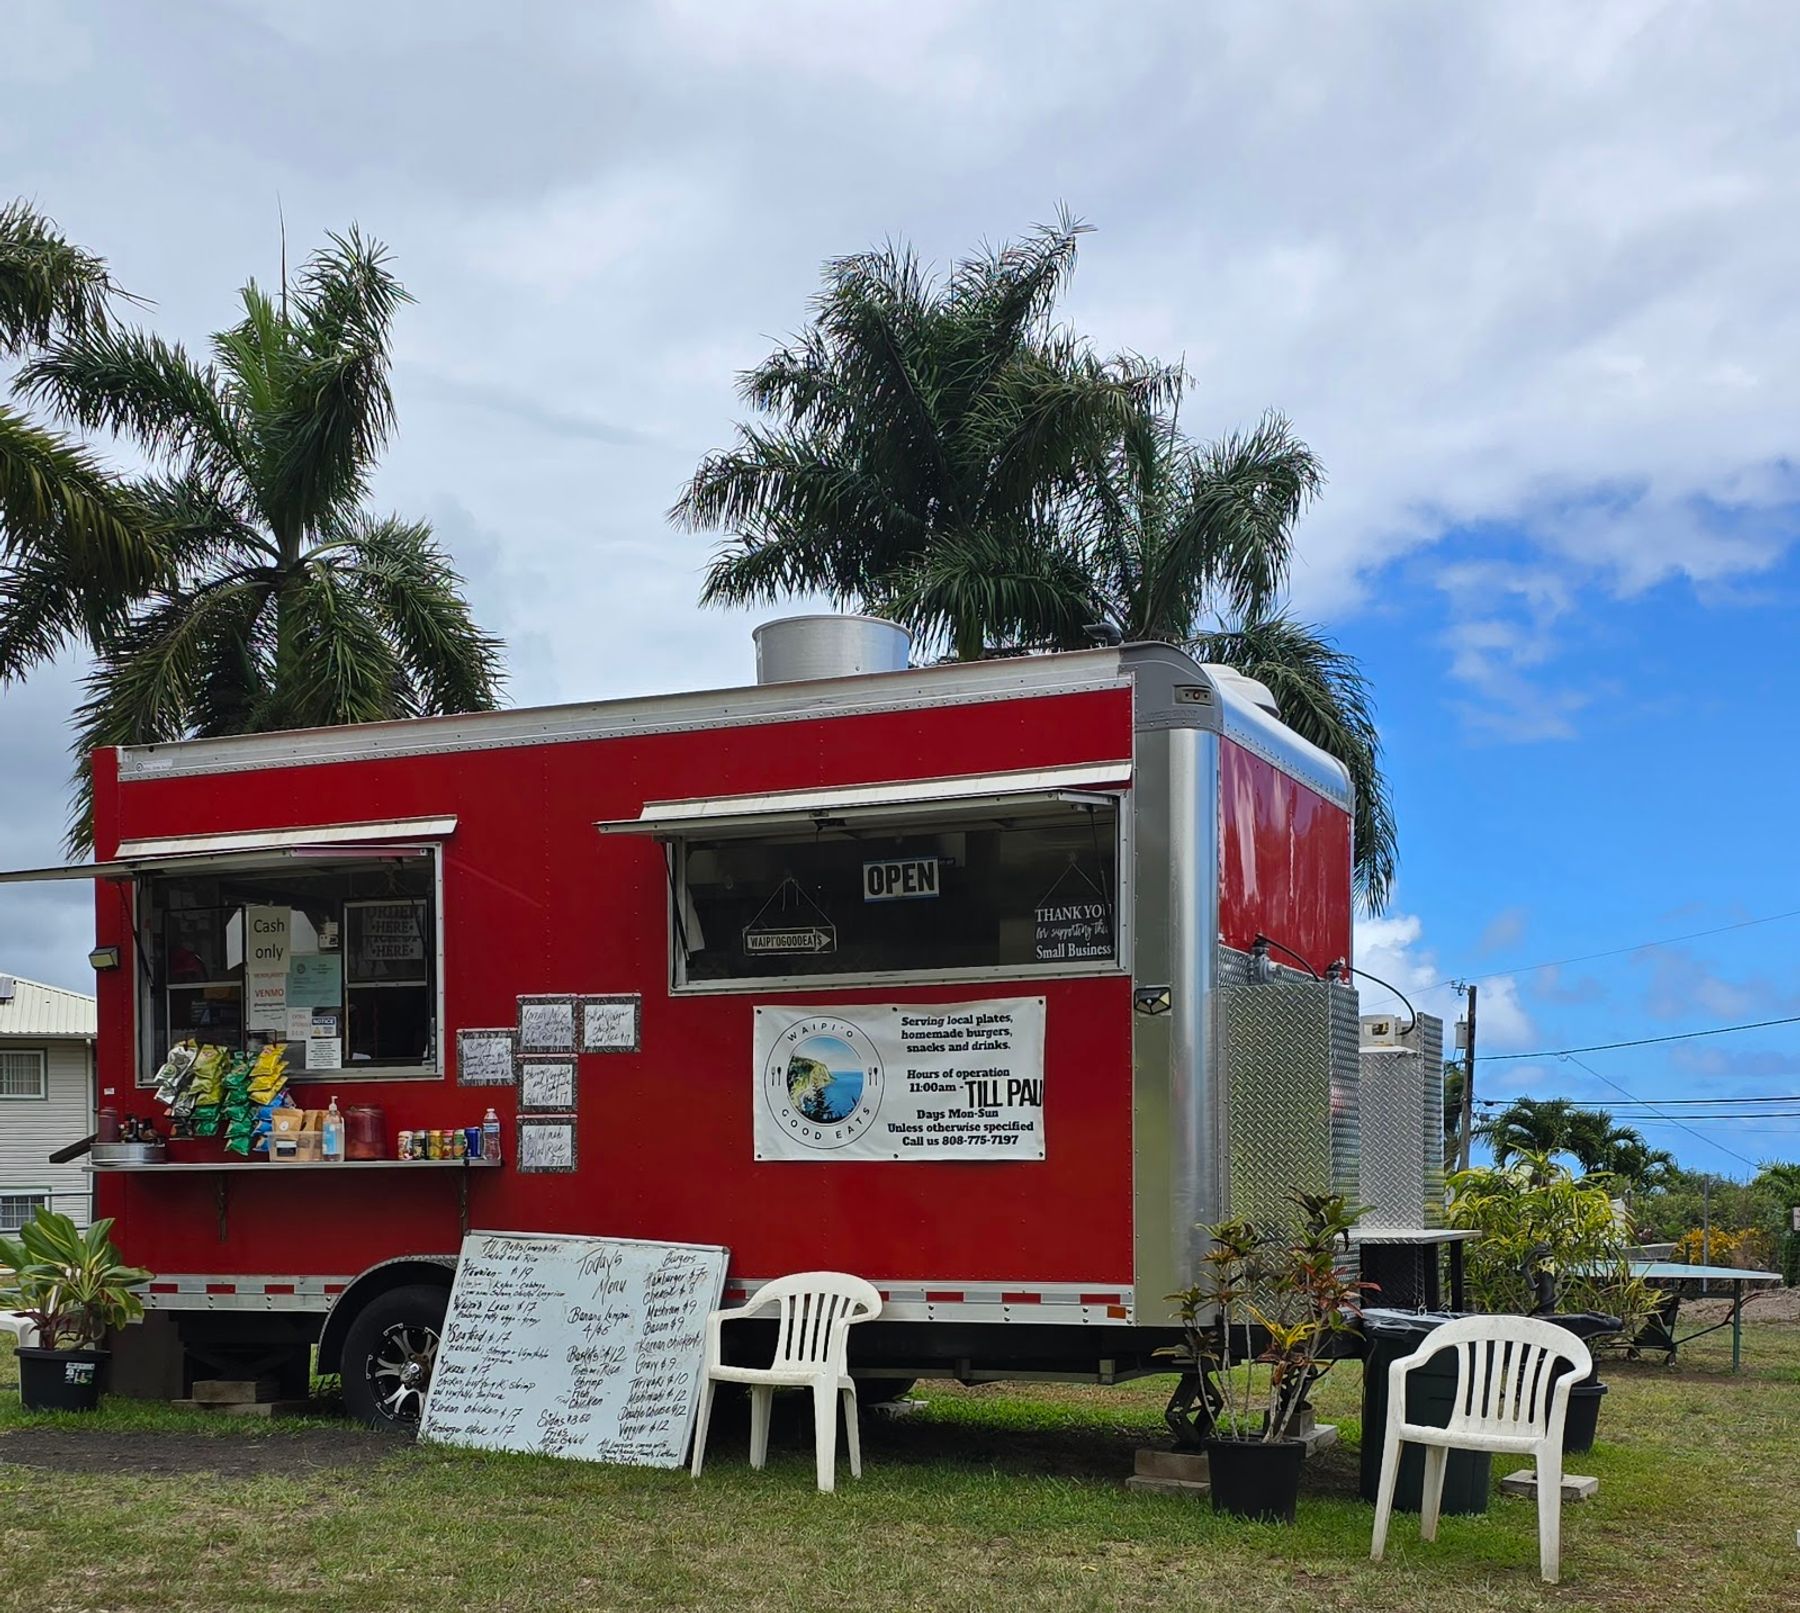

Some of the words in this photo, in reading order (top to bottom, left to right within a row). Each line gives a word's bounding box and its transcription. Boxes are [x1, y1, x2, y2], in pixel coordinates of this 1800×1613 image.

[867, 861, 935, 895] OPEN
[1035, 905, 1082, 922] THANK
[253, 917, 285, 934] Cash
[376, 921, 410, 933] HERE
[255, 943, 283, 961] only
[376, 944, 410, 957] HERE
[1036, 943, 1065, 959] Small
[1067, 942, 1112, 957] Business
[254, 988, 284, 998] VENMO
[901, 1017, 944, 1027] Serving
[947, 1014, 973, 1025] local
[975, 1013, 1013, 1026] plates,
[787, 1022, 853, 1042] WAIPI'O
[901, 1029, 964, 1039] homemade
[966, 1028, 1012, 1038] burgers,
[906, 1042, 945, 1052] snacks
[948, 1041, 969, 1051] and
[972, 1040, 1011, 1050] drinks.
[907, 1069, 940, 1079] Hours
[942, 1068, 954, 1079] of
[956, 1067, 1010, 1080] operation
[910, 1082, 956, 1093] 11:00am
[965, 1079, 1003, 1108] TILL
[1007, 1079, 1042, 1107] PAU
[916, 1109, 945, 1121] Days
[948, 1109, 999, 1119] Mon-Sun
[782, 1109, 822, 1140] GOOD
[835, 1107, 870, 1139] EATS
[887, 1123, 924, 1133] Unless
[926, 1121, 981, 1132] otherwise
[983, 1121, 1034, 1134] specified
[902, 1136, 924, 1146] Call
[927, 1138, 940, 1146] us
[942, 1135, 1019, 1146] 808-775-7197
[576, 1247, 623, 1280] Today's
[661, 1250, 697, 1269] Burgers
[666, 1372, 689, 1387] $10
